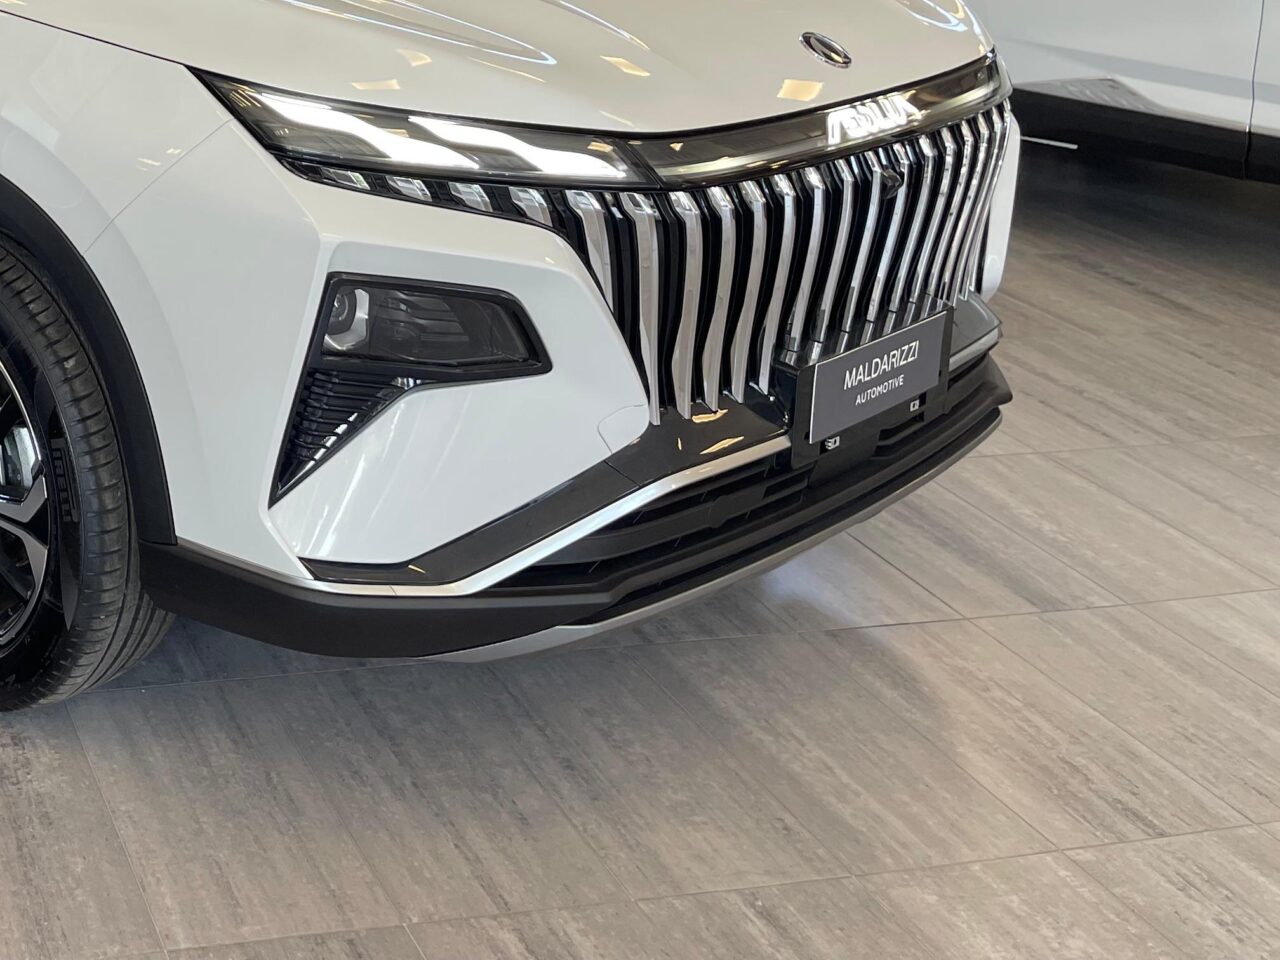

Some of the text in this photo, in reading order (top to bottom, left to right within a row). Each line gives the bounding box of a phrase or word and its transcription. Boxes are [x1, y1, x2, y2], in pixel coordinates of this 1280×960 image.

[843, 340, 920, 390] MALDARIZZI
[855, 374, 905, 406] AUTOMOTIVE
[50, 438, 79, 522] PIRELLI
